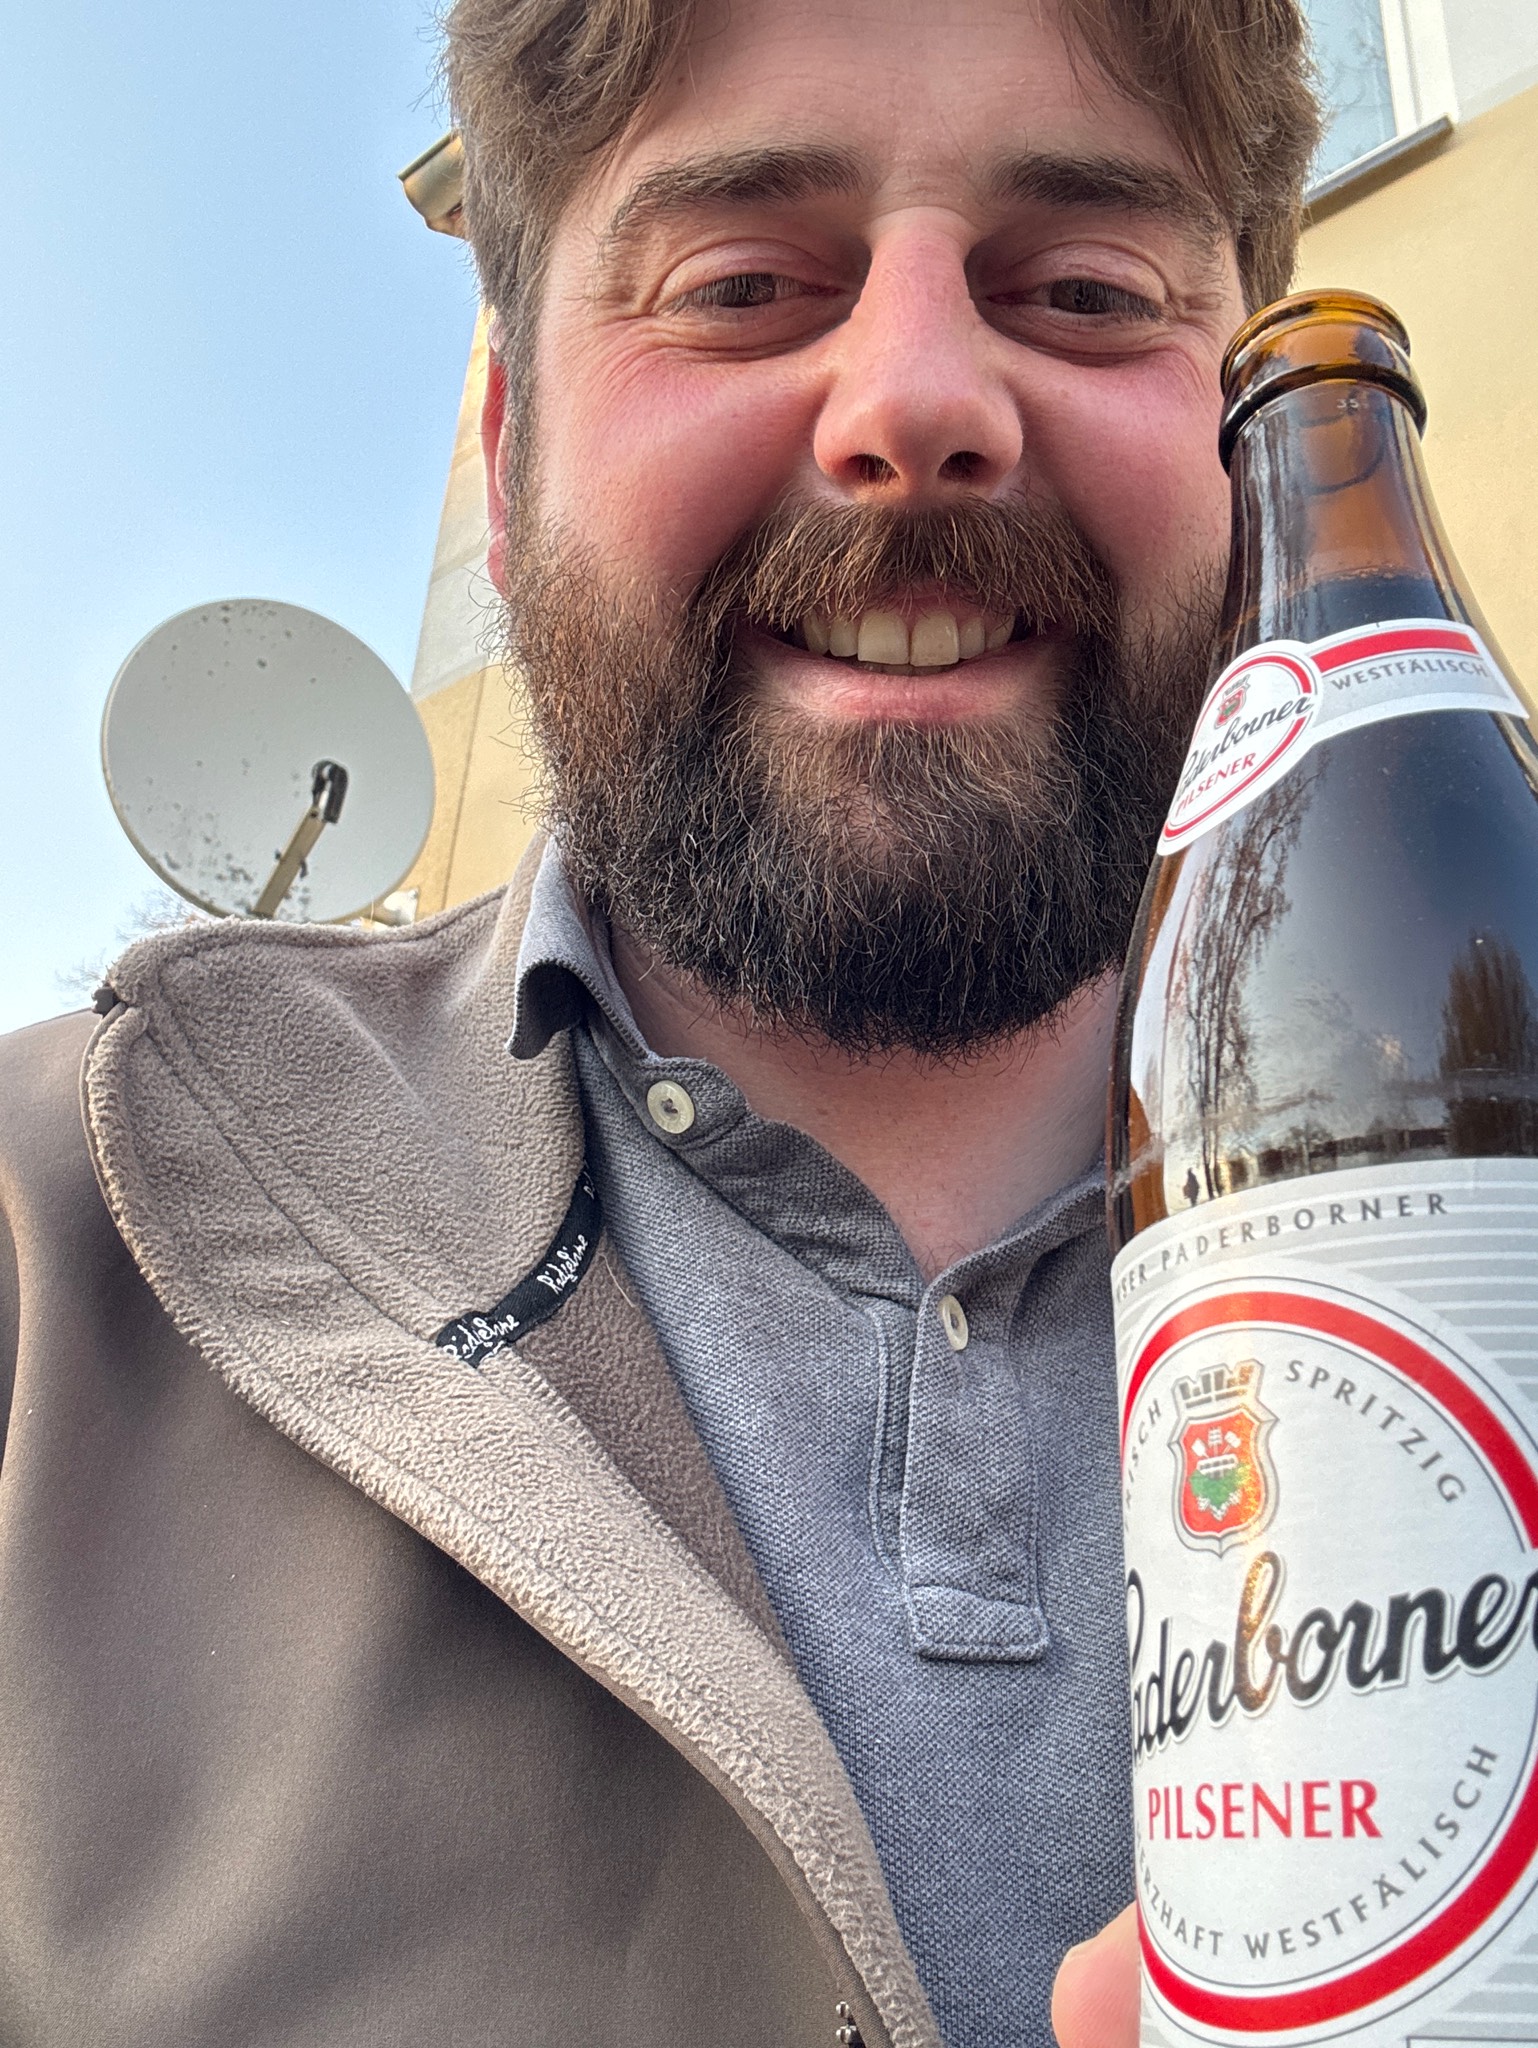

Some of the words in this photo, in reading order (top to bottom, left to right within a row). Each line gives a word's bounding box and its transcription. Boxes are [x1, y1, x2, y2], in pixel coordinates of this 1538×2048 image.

[1331, 659, 1489, 691] WESTFÄLISCH
[1175, 752, 1257, 818] PILSENER
[1161, 1193, 1448, 1271] PADERBORNER
[1285, 1359, 1468, 1503] SPRITZIG
[1147, 1778, 1384, 1841] PILSENER
[1243, 1744, 1498, 1959] WESTFÄLISCH
